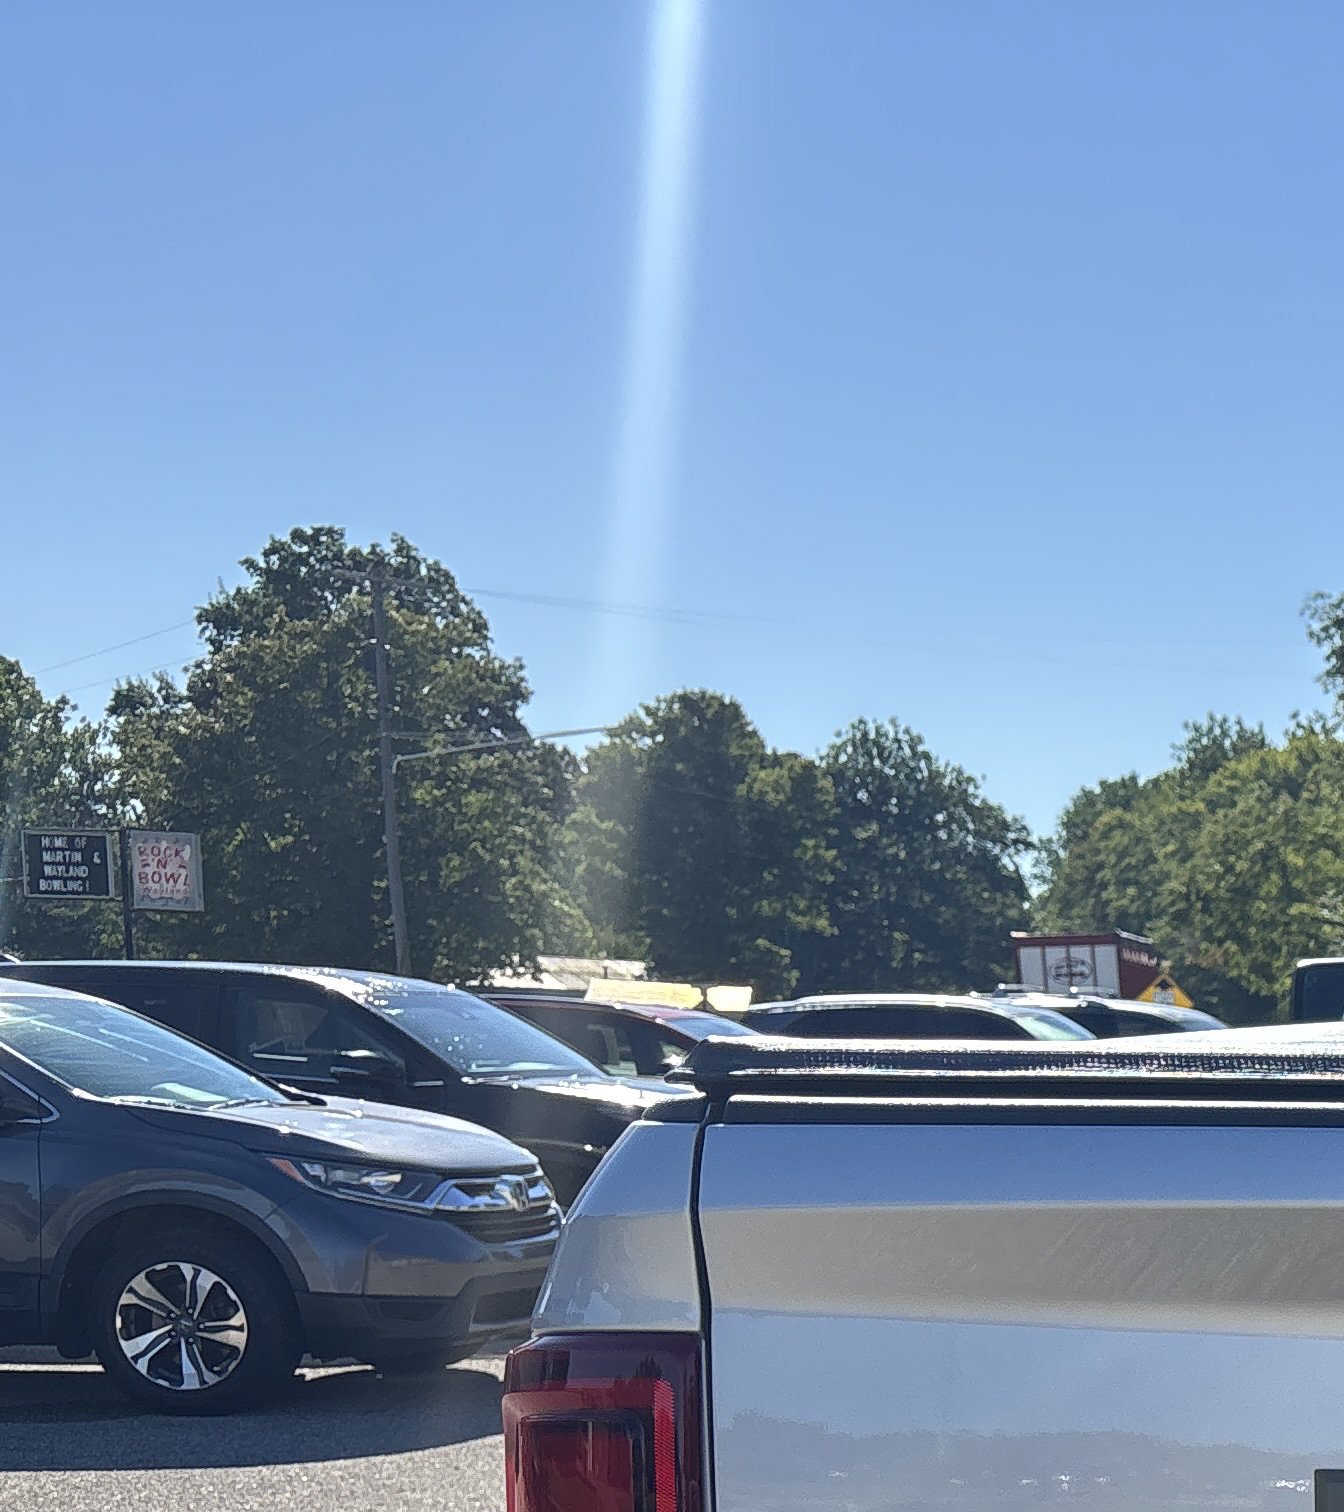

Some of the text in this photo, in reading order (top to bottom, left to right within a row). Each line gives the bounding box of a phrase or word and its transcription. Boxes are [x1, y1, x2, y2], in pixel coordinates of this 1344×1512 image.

[41, 836, 87, 849] HOME OF
[42, 851, 101, 864] MARTIN &
[138, 845, 187, 858] ROCK
[43, 865, 89, 878] WAYLAND
[138, 871, 190, 887] BOWL
